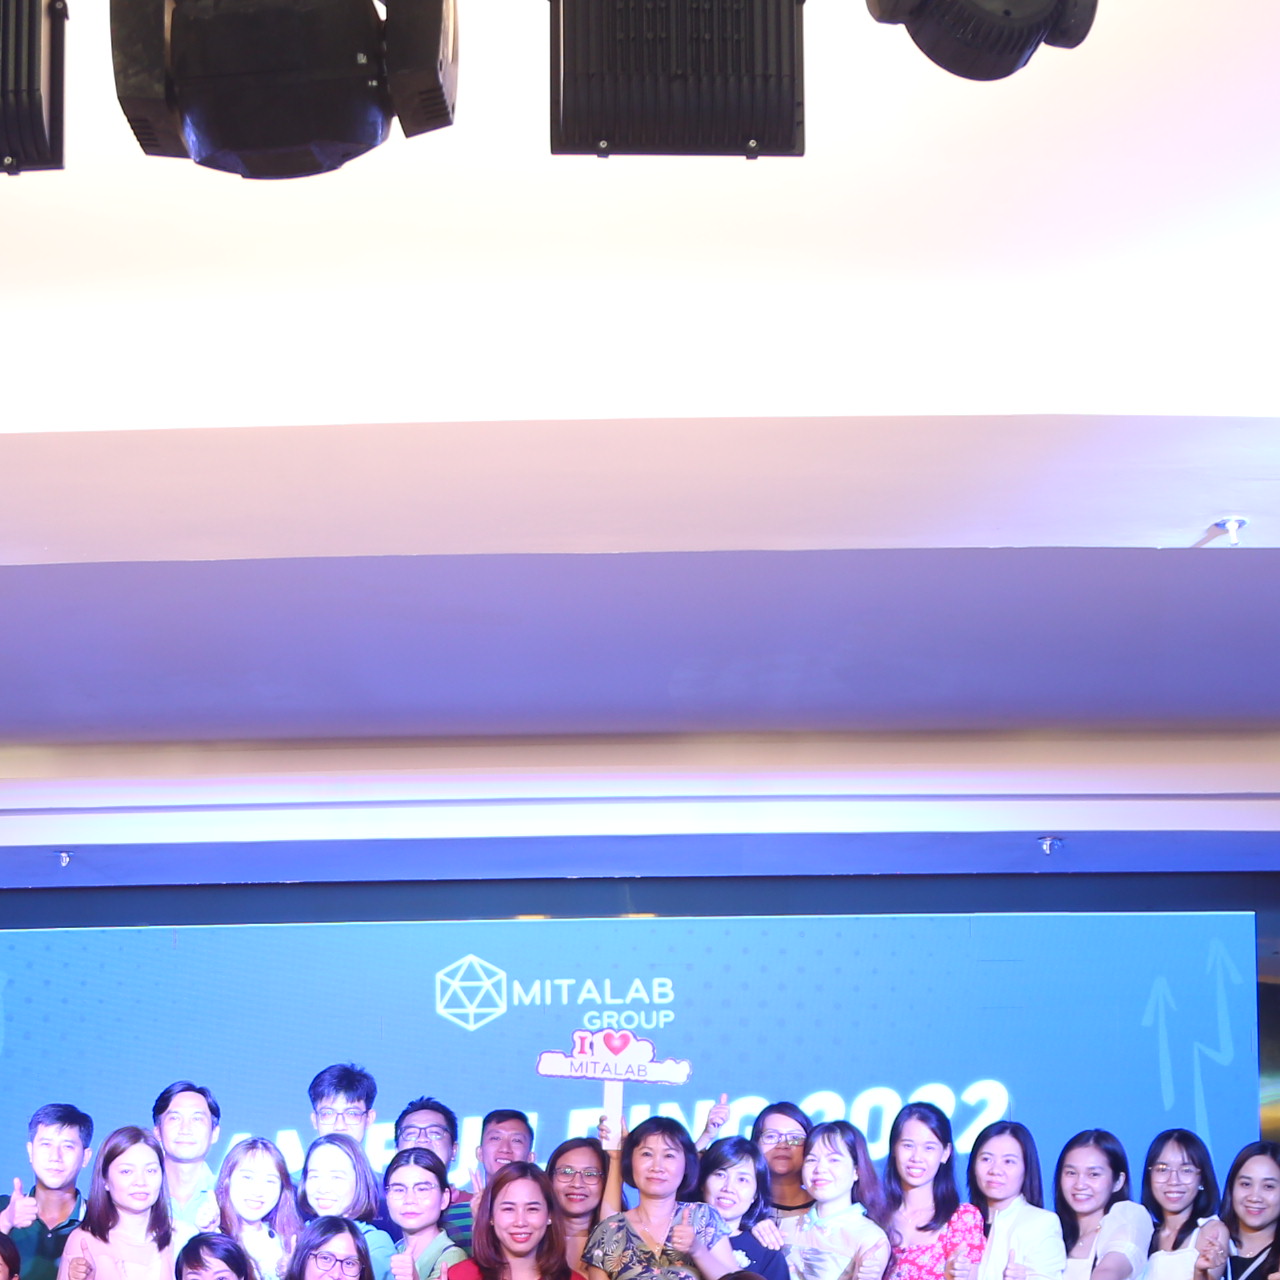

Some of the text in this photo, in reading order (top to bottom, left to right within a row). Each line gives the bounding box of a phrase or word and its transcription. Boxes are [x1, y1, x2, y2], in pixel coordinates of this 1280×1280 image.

[512, 977, 676, 1006] MITALAB
[582, 1010, 676, 1030] GROUP
[578, 1035, 588, 1055] I
[569, 1061, 649, 1077] MITALAB
